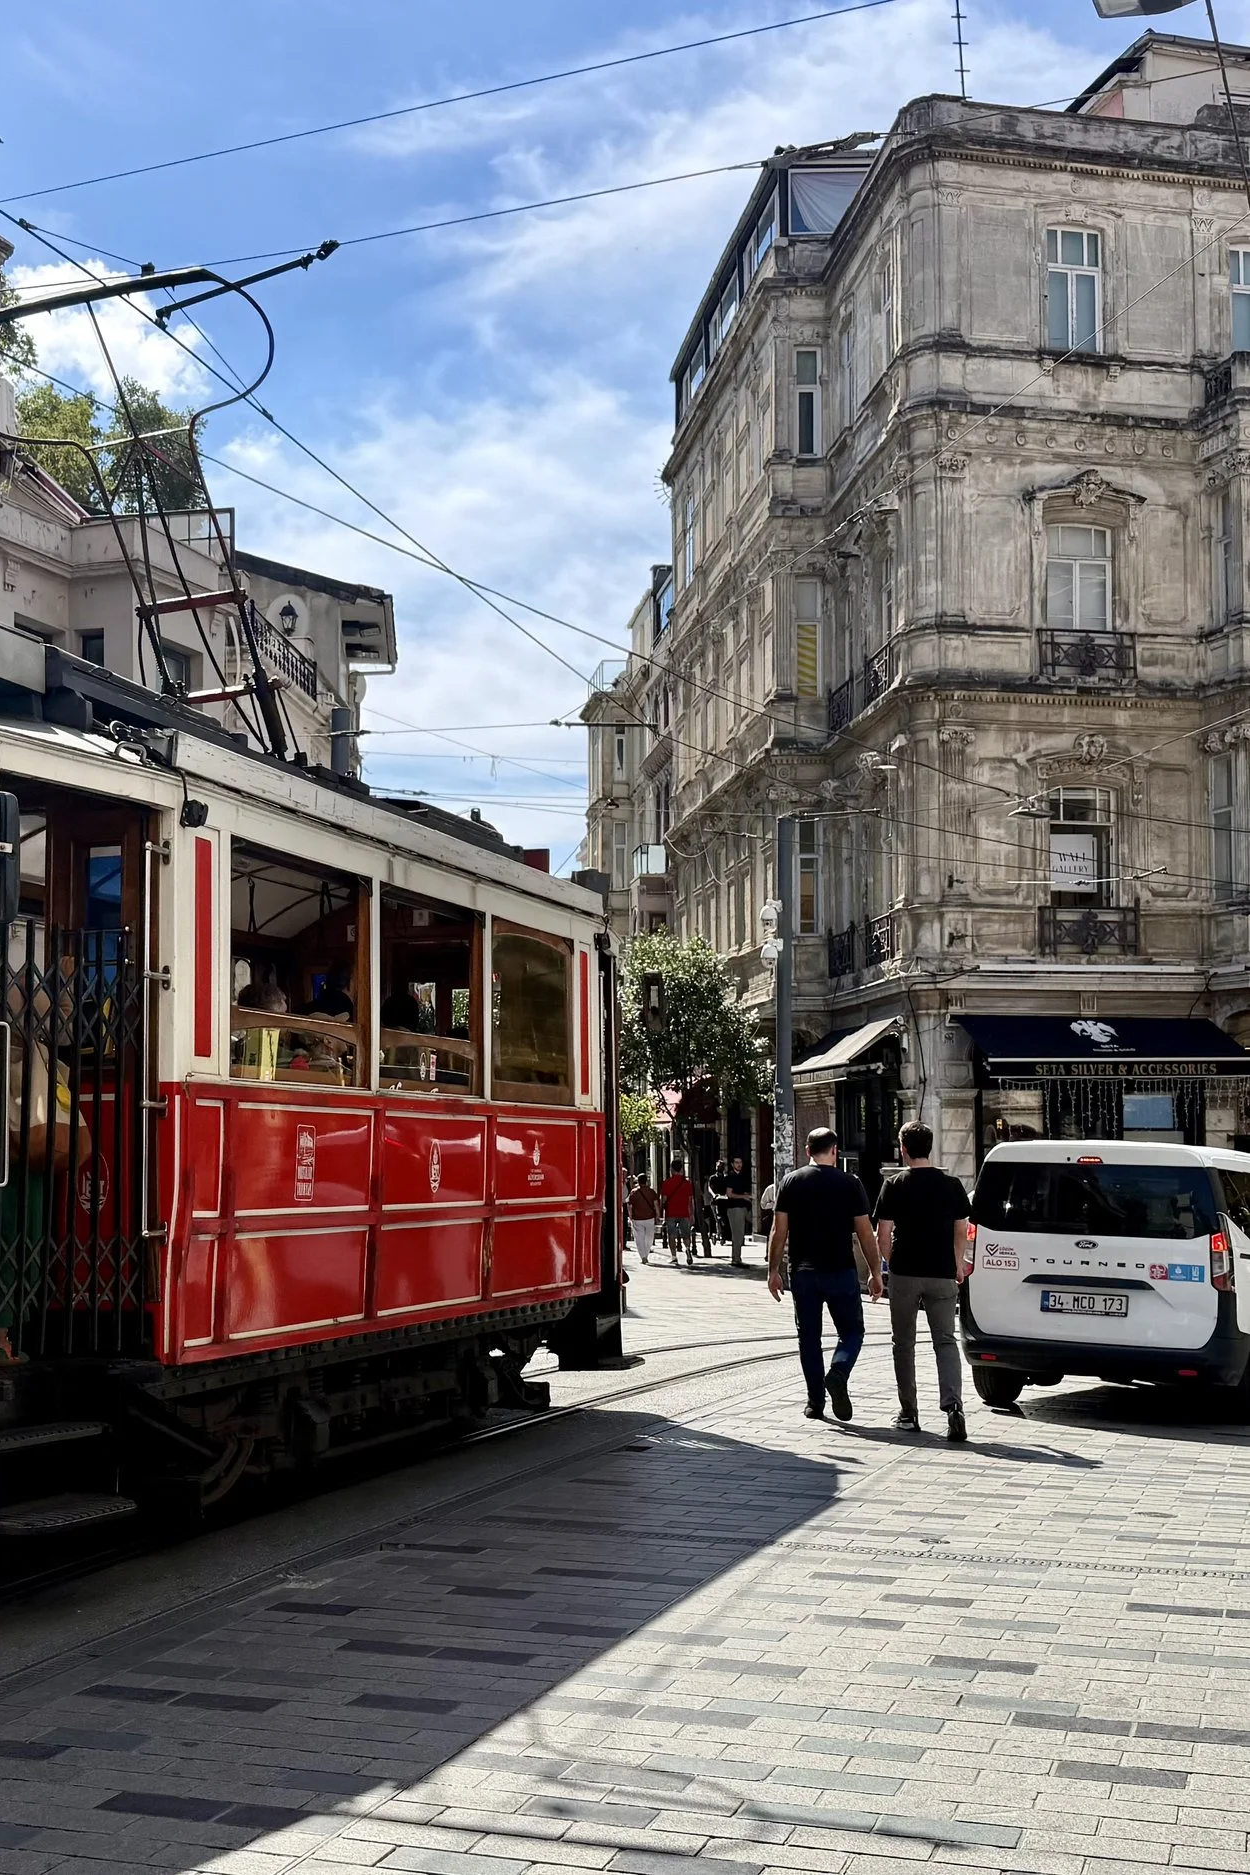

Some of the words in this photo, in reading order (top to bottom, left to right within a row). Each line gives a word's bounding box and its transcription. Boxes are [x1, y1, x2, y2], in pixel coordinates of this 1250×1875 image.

[1035, 1064, 1066, 1076] SETA
[1071, 1064, 1114, 1076] SILVER
[1132, 1063, 1218, 1075] ACCESSORIES
[1029, 1257, 1146, 1269] TOURNEO
[1050, 1294, 1064, 1308] 34
[1072, 1296, 1095, 1310] MCD
[1103, 1297, 1123, 1311] 173
